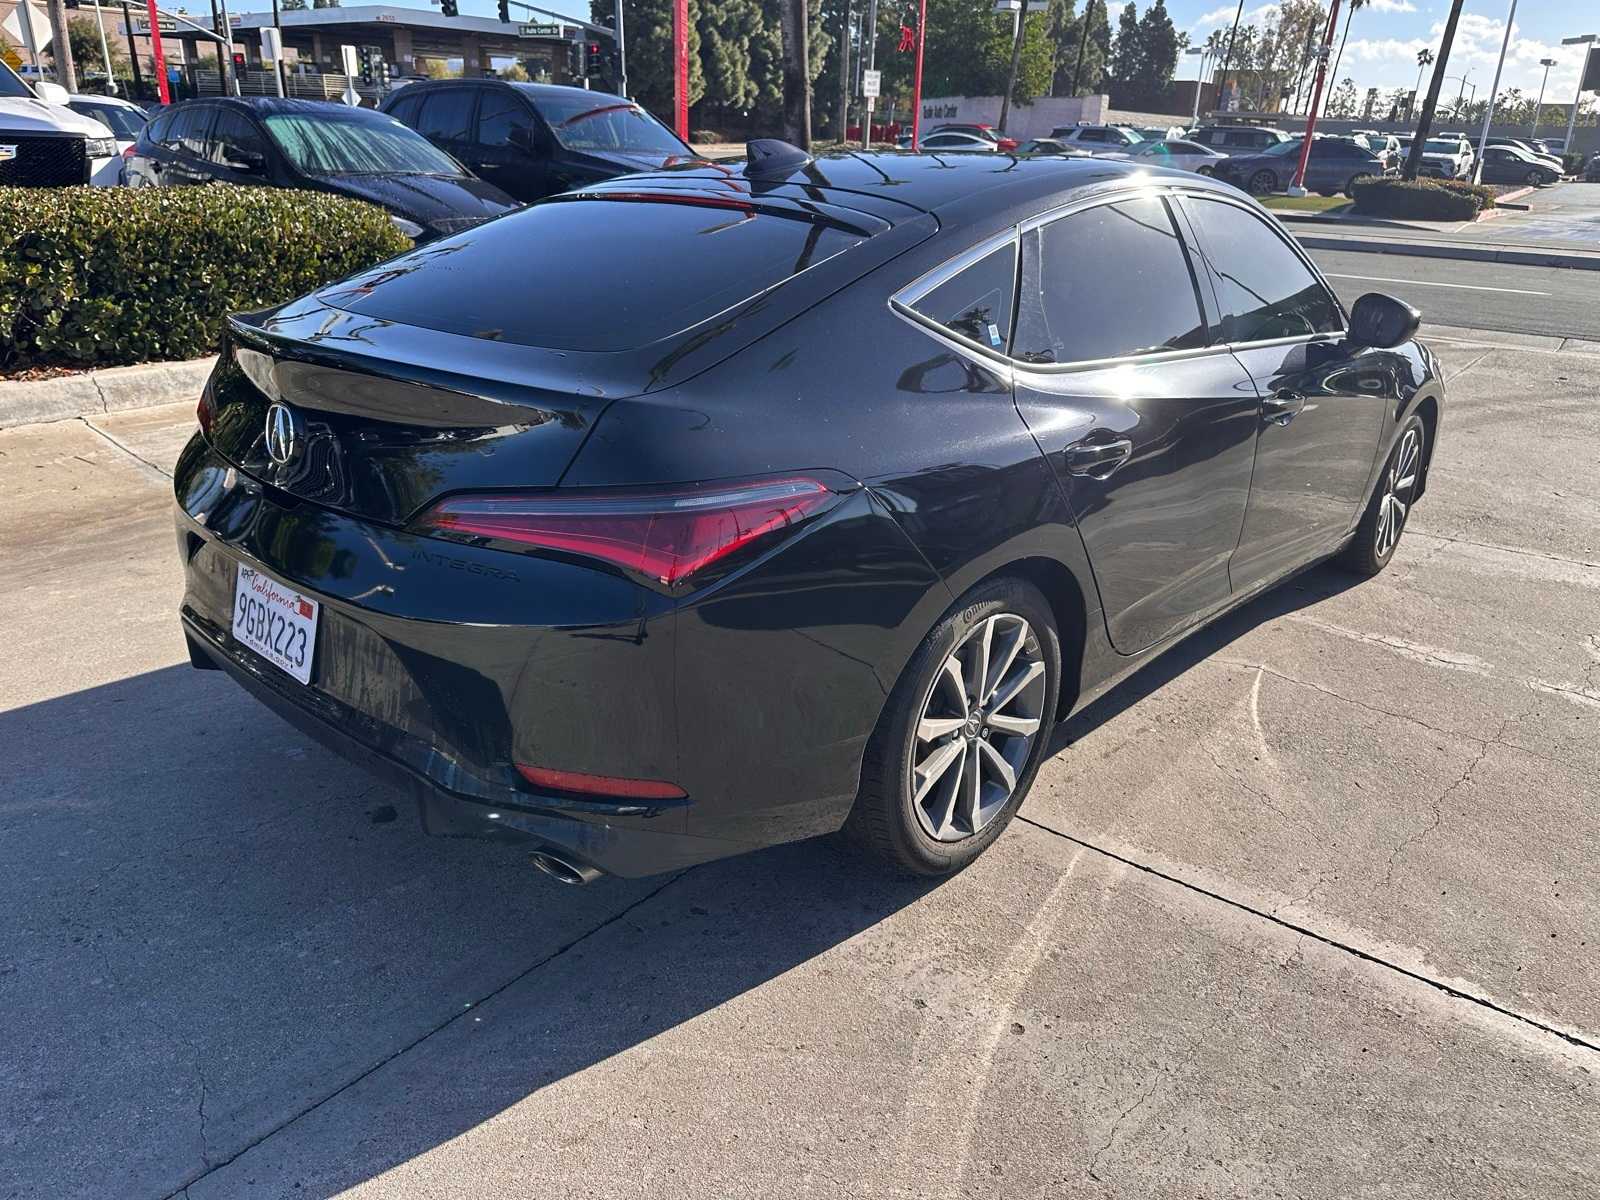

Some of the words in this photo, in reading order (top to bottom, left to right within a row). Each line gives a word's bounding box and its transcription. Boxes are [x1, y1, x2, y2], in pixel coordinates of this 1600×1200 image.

[411, 550, 521, 582] INTEGRA
[251, 573, 295, 609] California
[236, 592, 307, 668] 9GBX223
